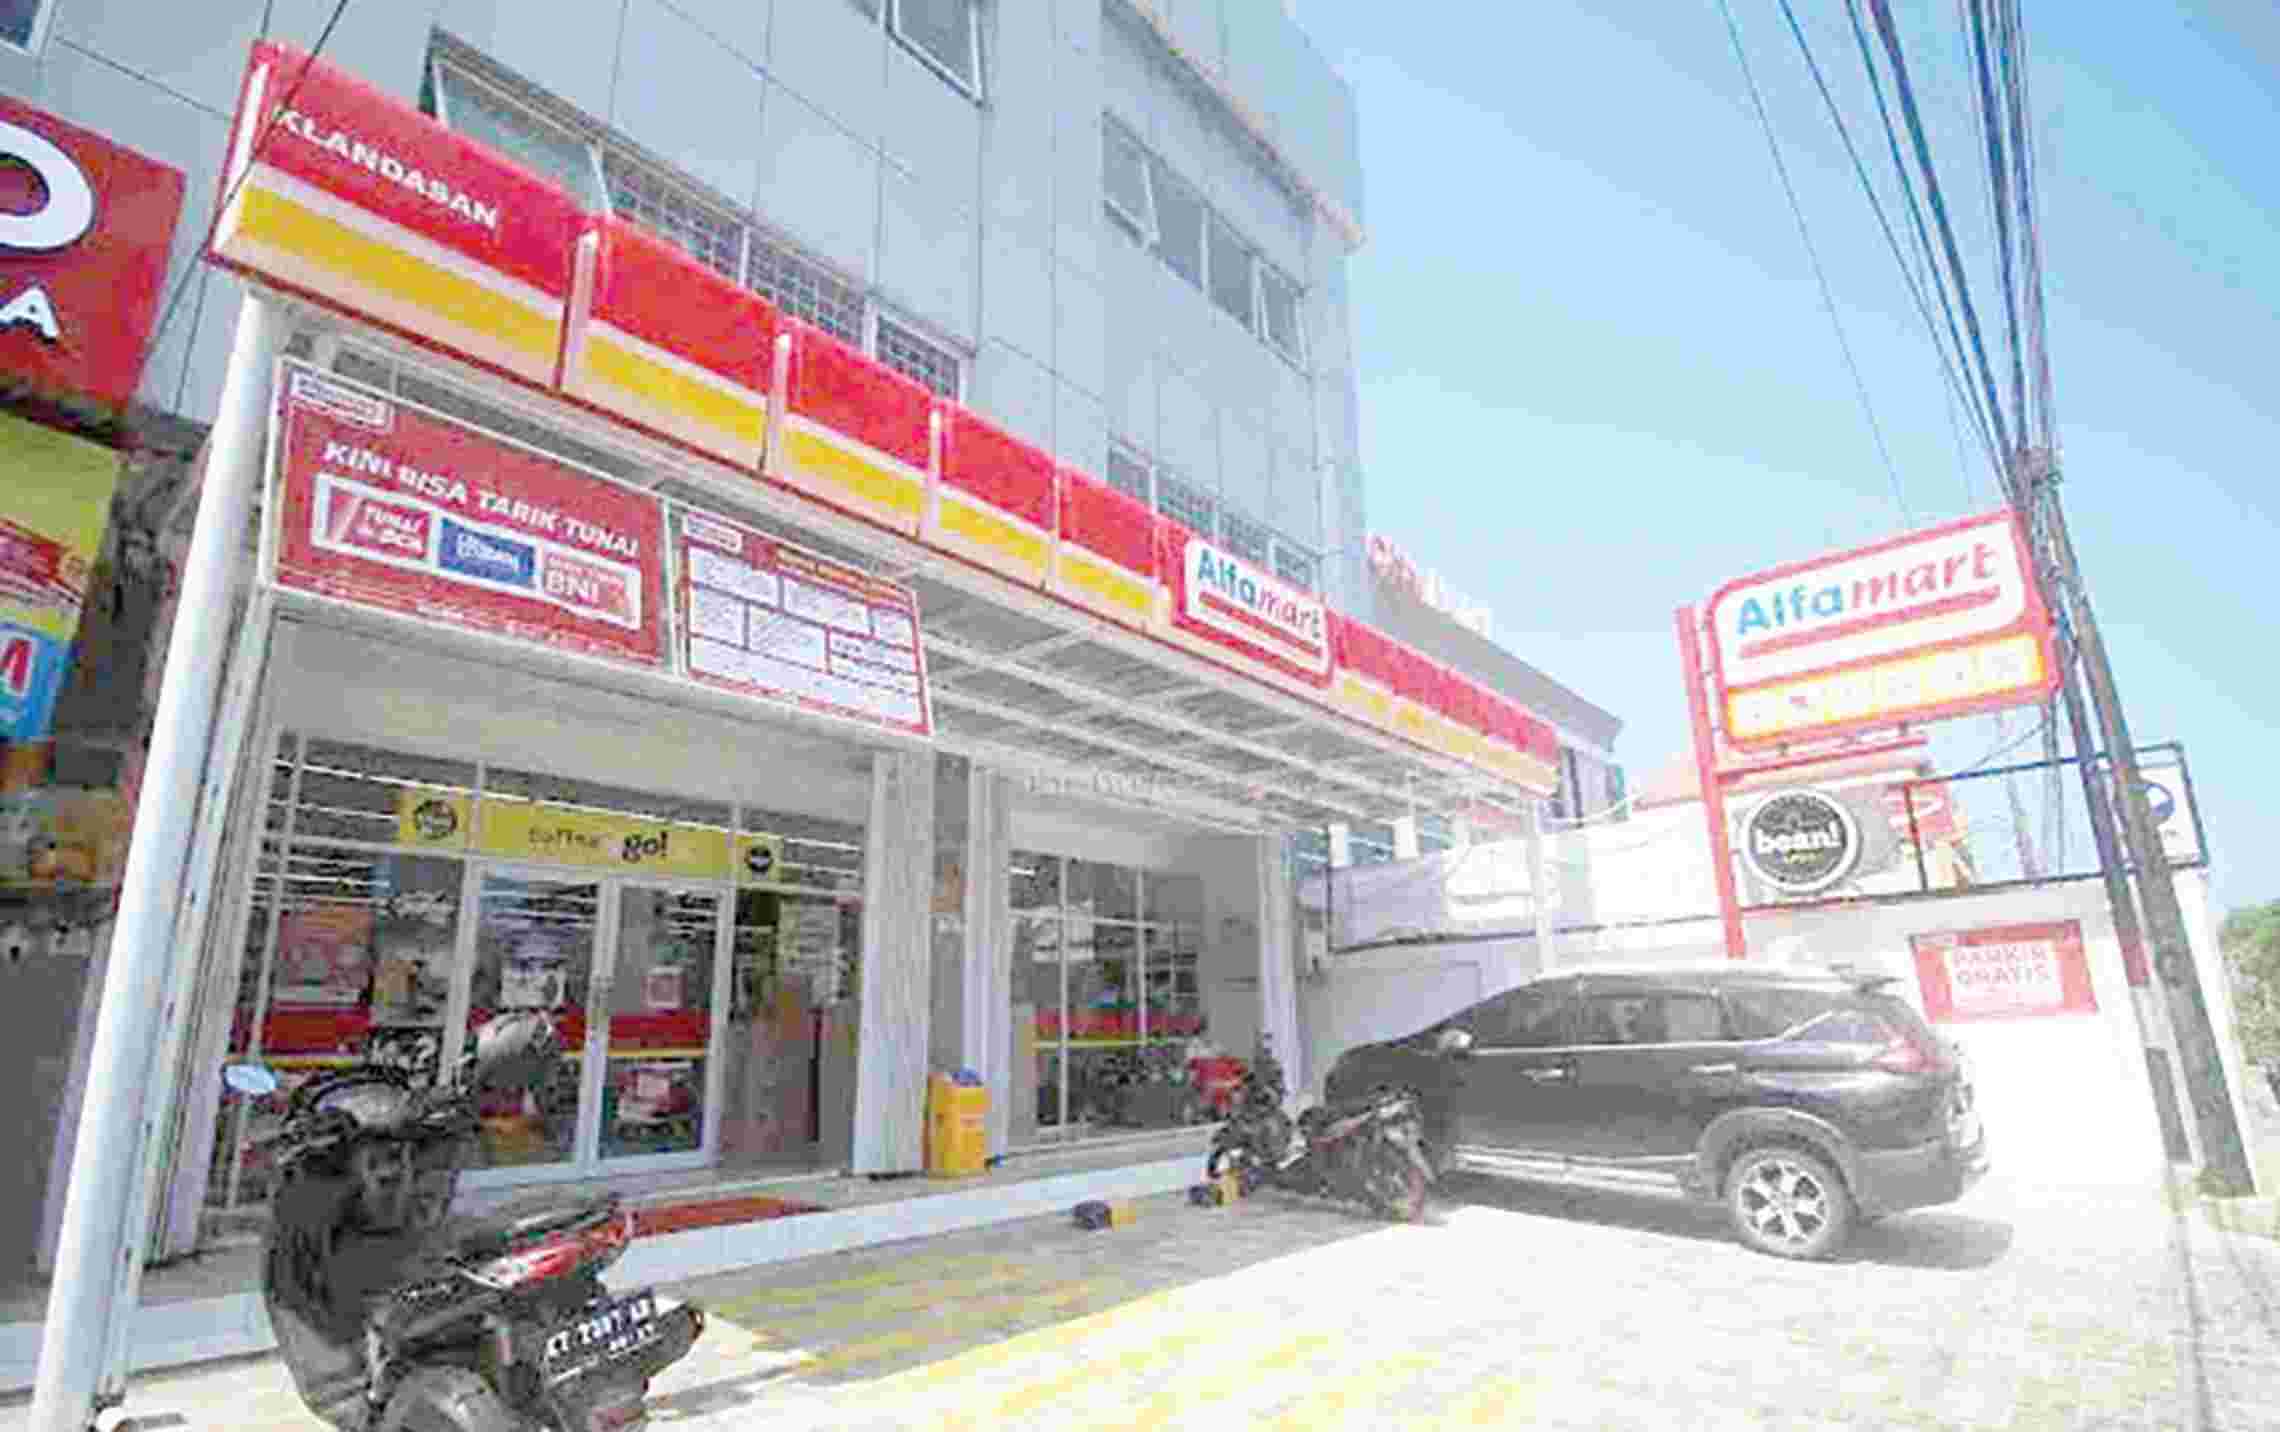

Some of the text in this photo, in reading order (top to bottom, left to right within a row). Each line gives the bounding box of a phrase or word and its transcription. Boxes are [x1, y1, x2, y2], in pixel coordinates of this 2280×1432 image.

[278, 109, 496, 229] KLANDASAN
[321, 442, 393, 480] KINI
[478, 488, 562, 532] TARIK
[1736, 542, 1999, 636] Alfamart
[621, 829, 669, 863] go!
[1755, 820, 1842, 855] bean!
